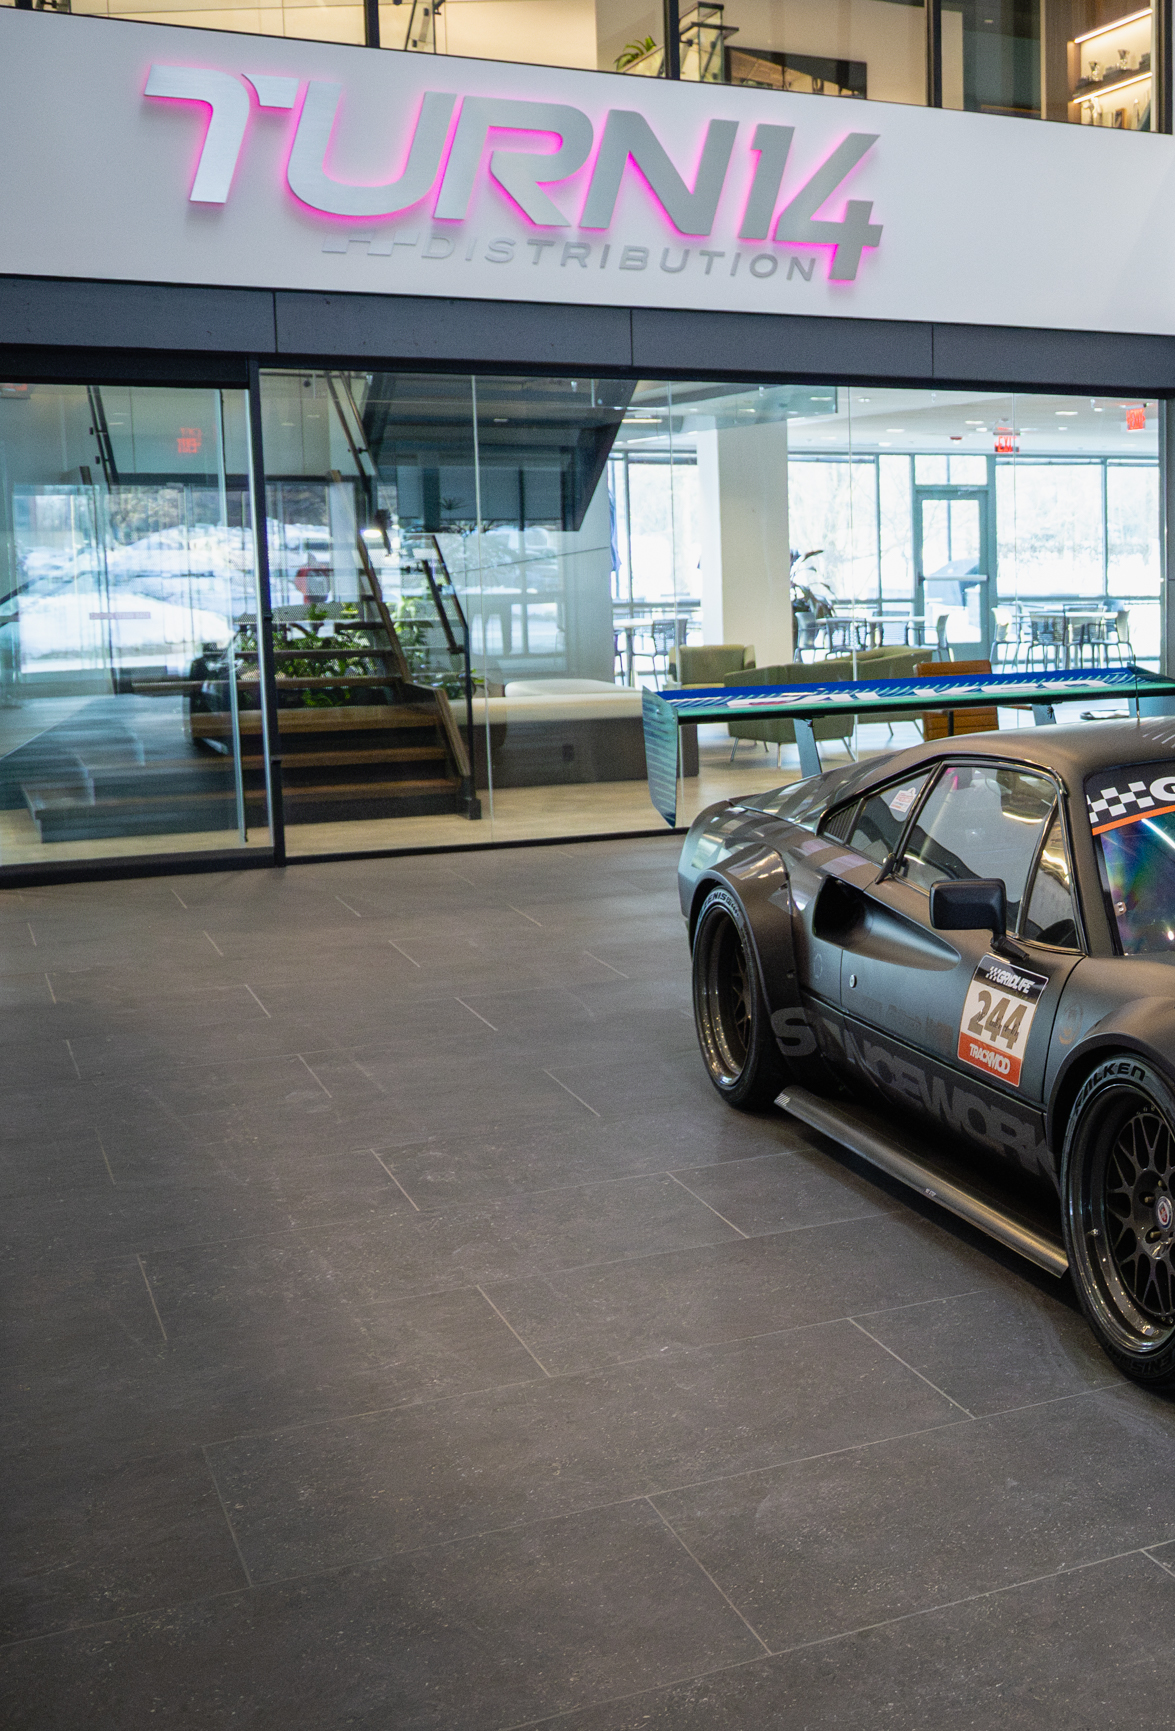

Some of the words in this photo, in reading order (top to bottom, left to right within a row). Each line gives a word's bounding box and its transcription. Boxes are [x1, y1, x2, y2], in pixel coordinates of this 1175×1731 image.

[143, 63, 883, 281] TURN14
[421, 233, 817, 283] DISTRIBUTION
[996, 970, 1036, 994] GRIDLIFE
[967, 990, 1028, 1050] 244
[1074, 1062, 1147, 1116] FALKEN
